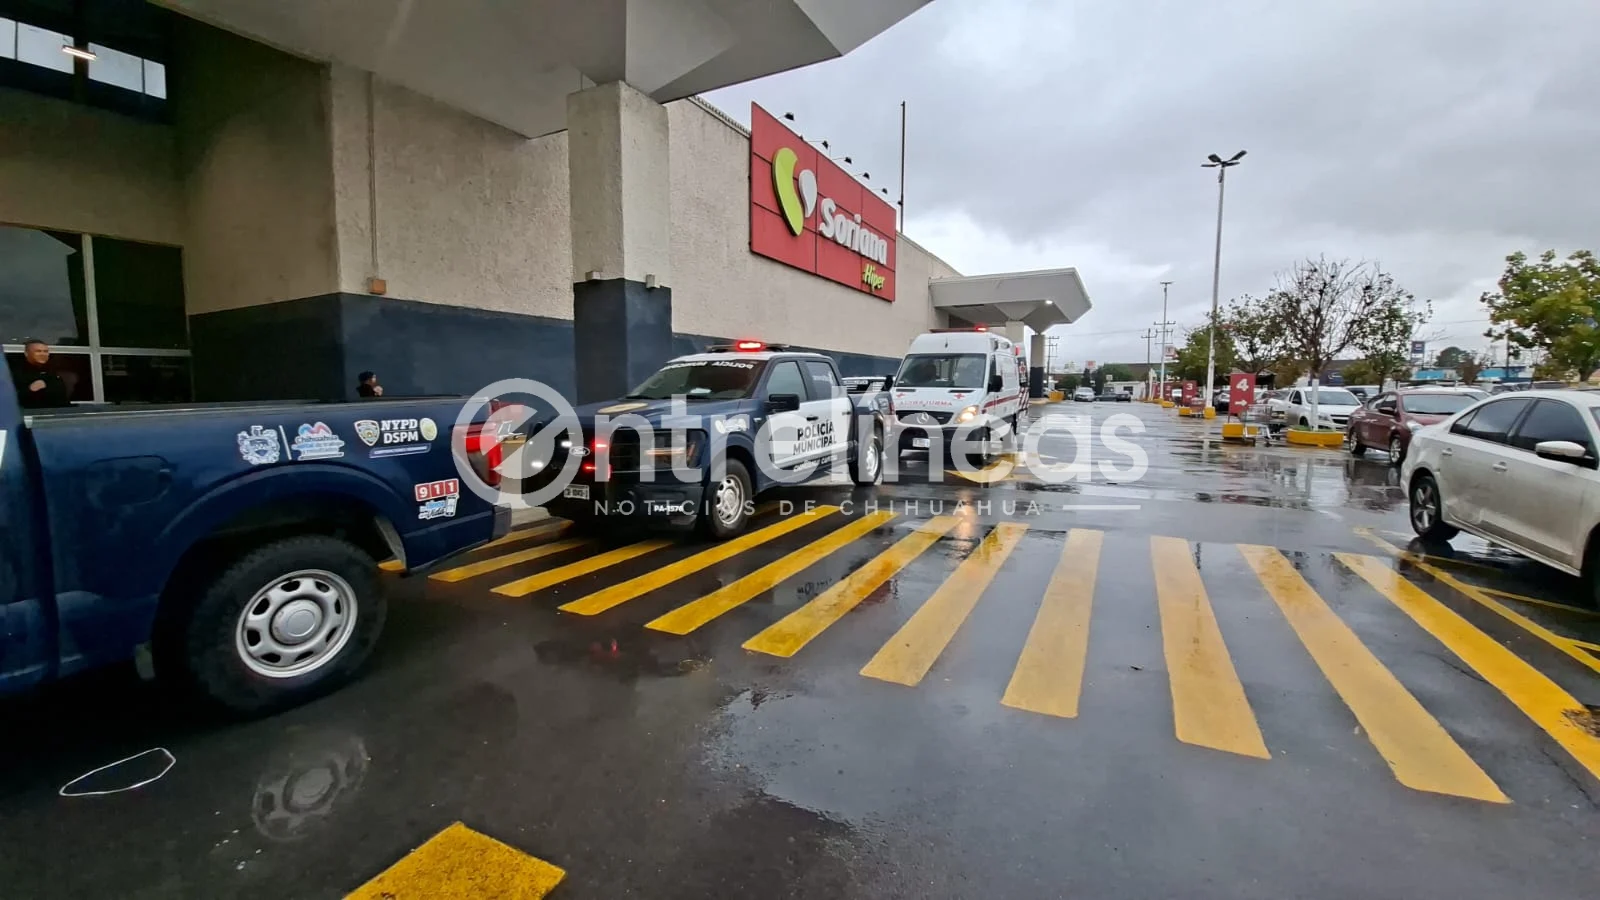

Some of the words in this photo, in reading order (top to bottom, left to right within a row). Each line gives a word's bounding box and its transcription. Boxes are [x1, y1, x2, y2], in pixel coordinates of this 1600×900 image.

[819, 198, 888, 265] Soriana
[862, 263, 886, 292] Hiper
[1236, 378, 1249, 391] 4
[381, 418, 418, 431] NYPD
[797, 419, 834, 441] POLICÍA
[383, 431, 418, 444] DSPM
[793, 435, 837, 456] MUNICIPAL
[419, 481, 455, 499] 911
